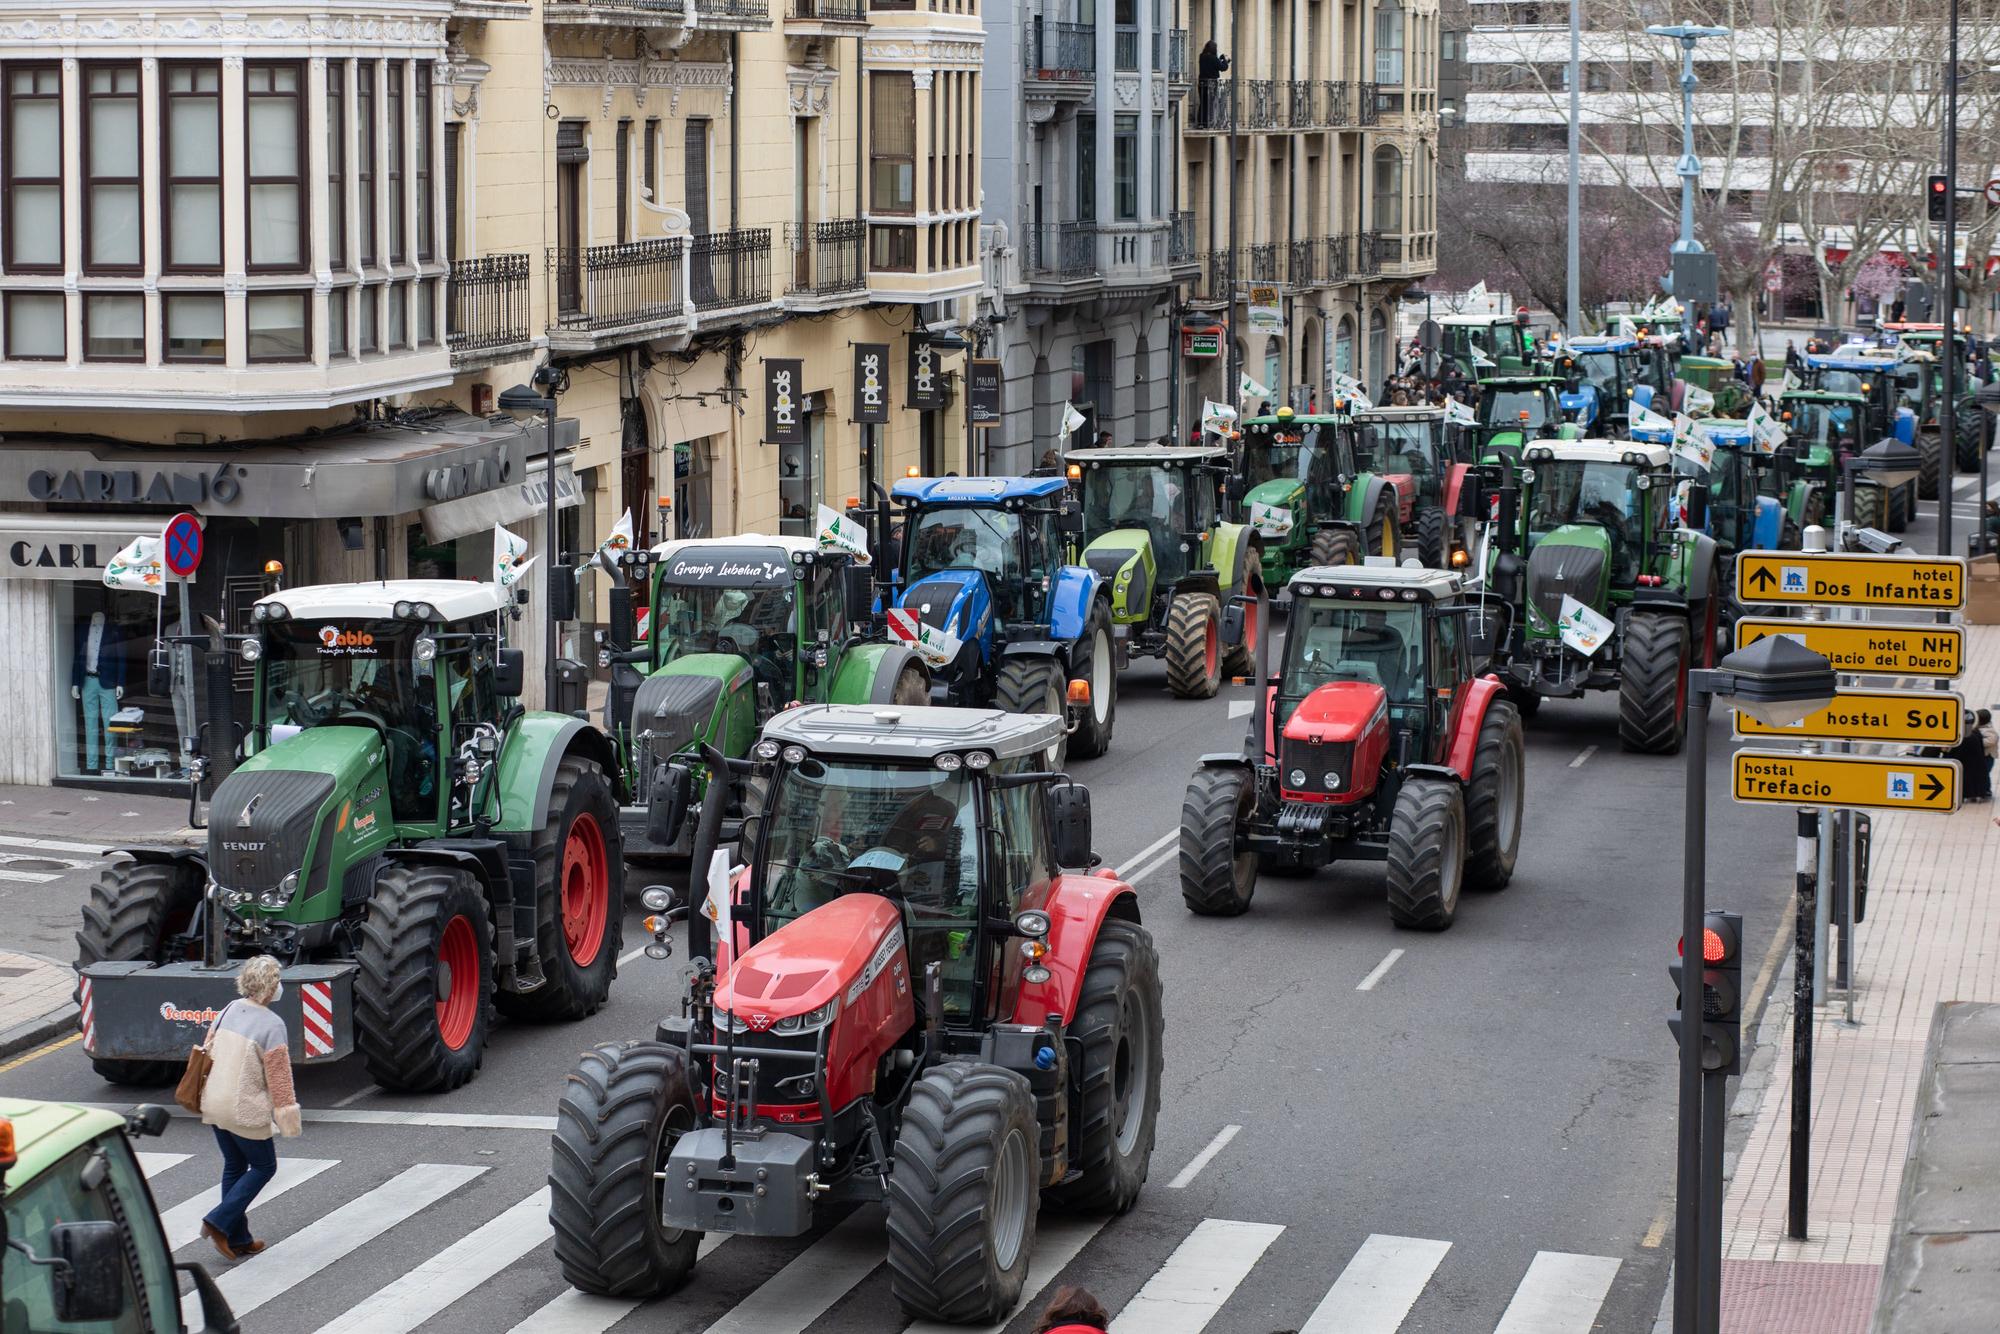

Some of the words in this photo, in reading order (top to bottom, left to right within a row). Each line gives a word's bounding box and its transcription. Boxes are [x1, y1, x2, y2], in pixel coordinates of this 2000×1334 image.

[674, 562, 715, 580] Granja
[1913, 569, 1953, 582] hotel
[1815, 581, 1851, 596] Dos
[1866, 582, 1953, 600] Infantas
[1869, 639, 1906, 651] hotel
[1923, 637, 1953, 653] NH
[1875, 654, 1898, 666] del
[1908, 655, 1952, 668] Duero
[1827, 711, 1889, 727] hostal
[1906, 709, 1950, 729] Sol
[1744, 762, 1794, 776] hostal
[1744, 777, 1832, 797] Trefacio
[222, 841, 266, 851] FENDT
